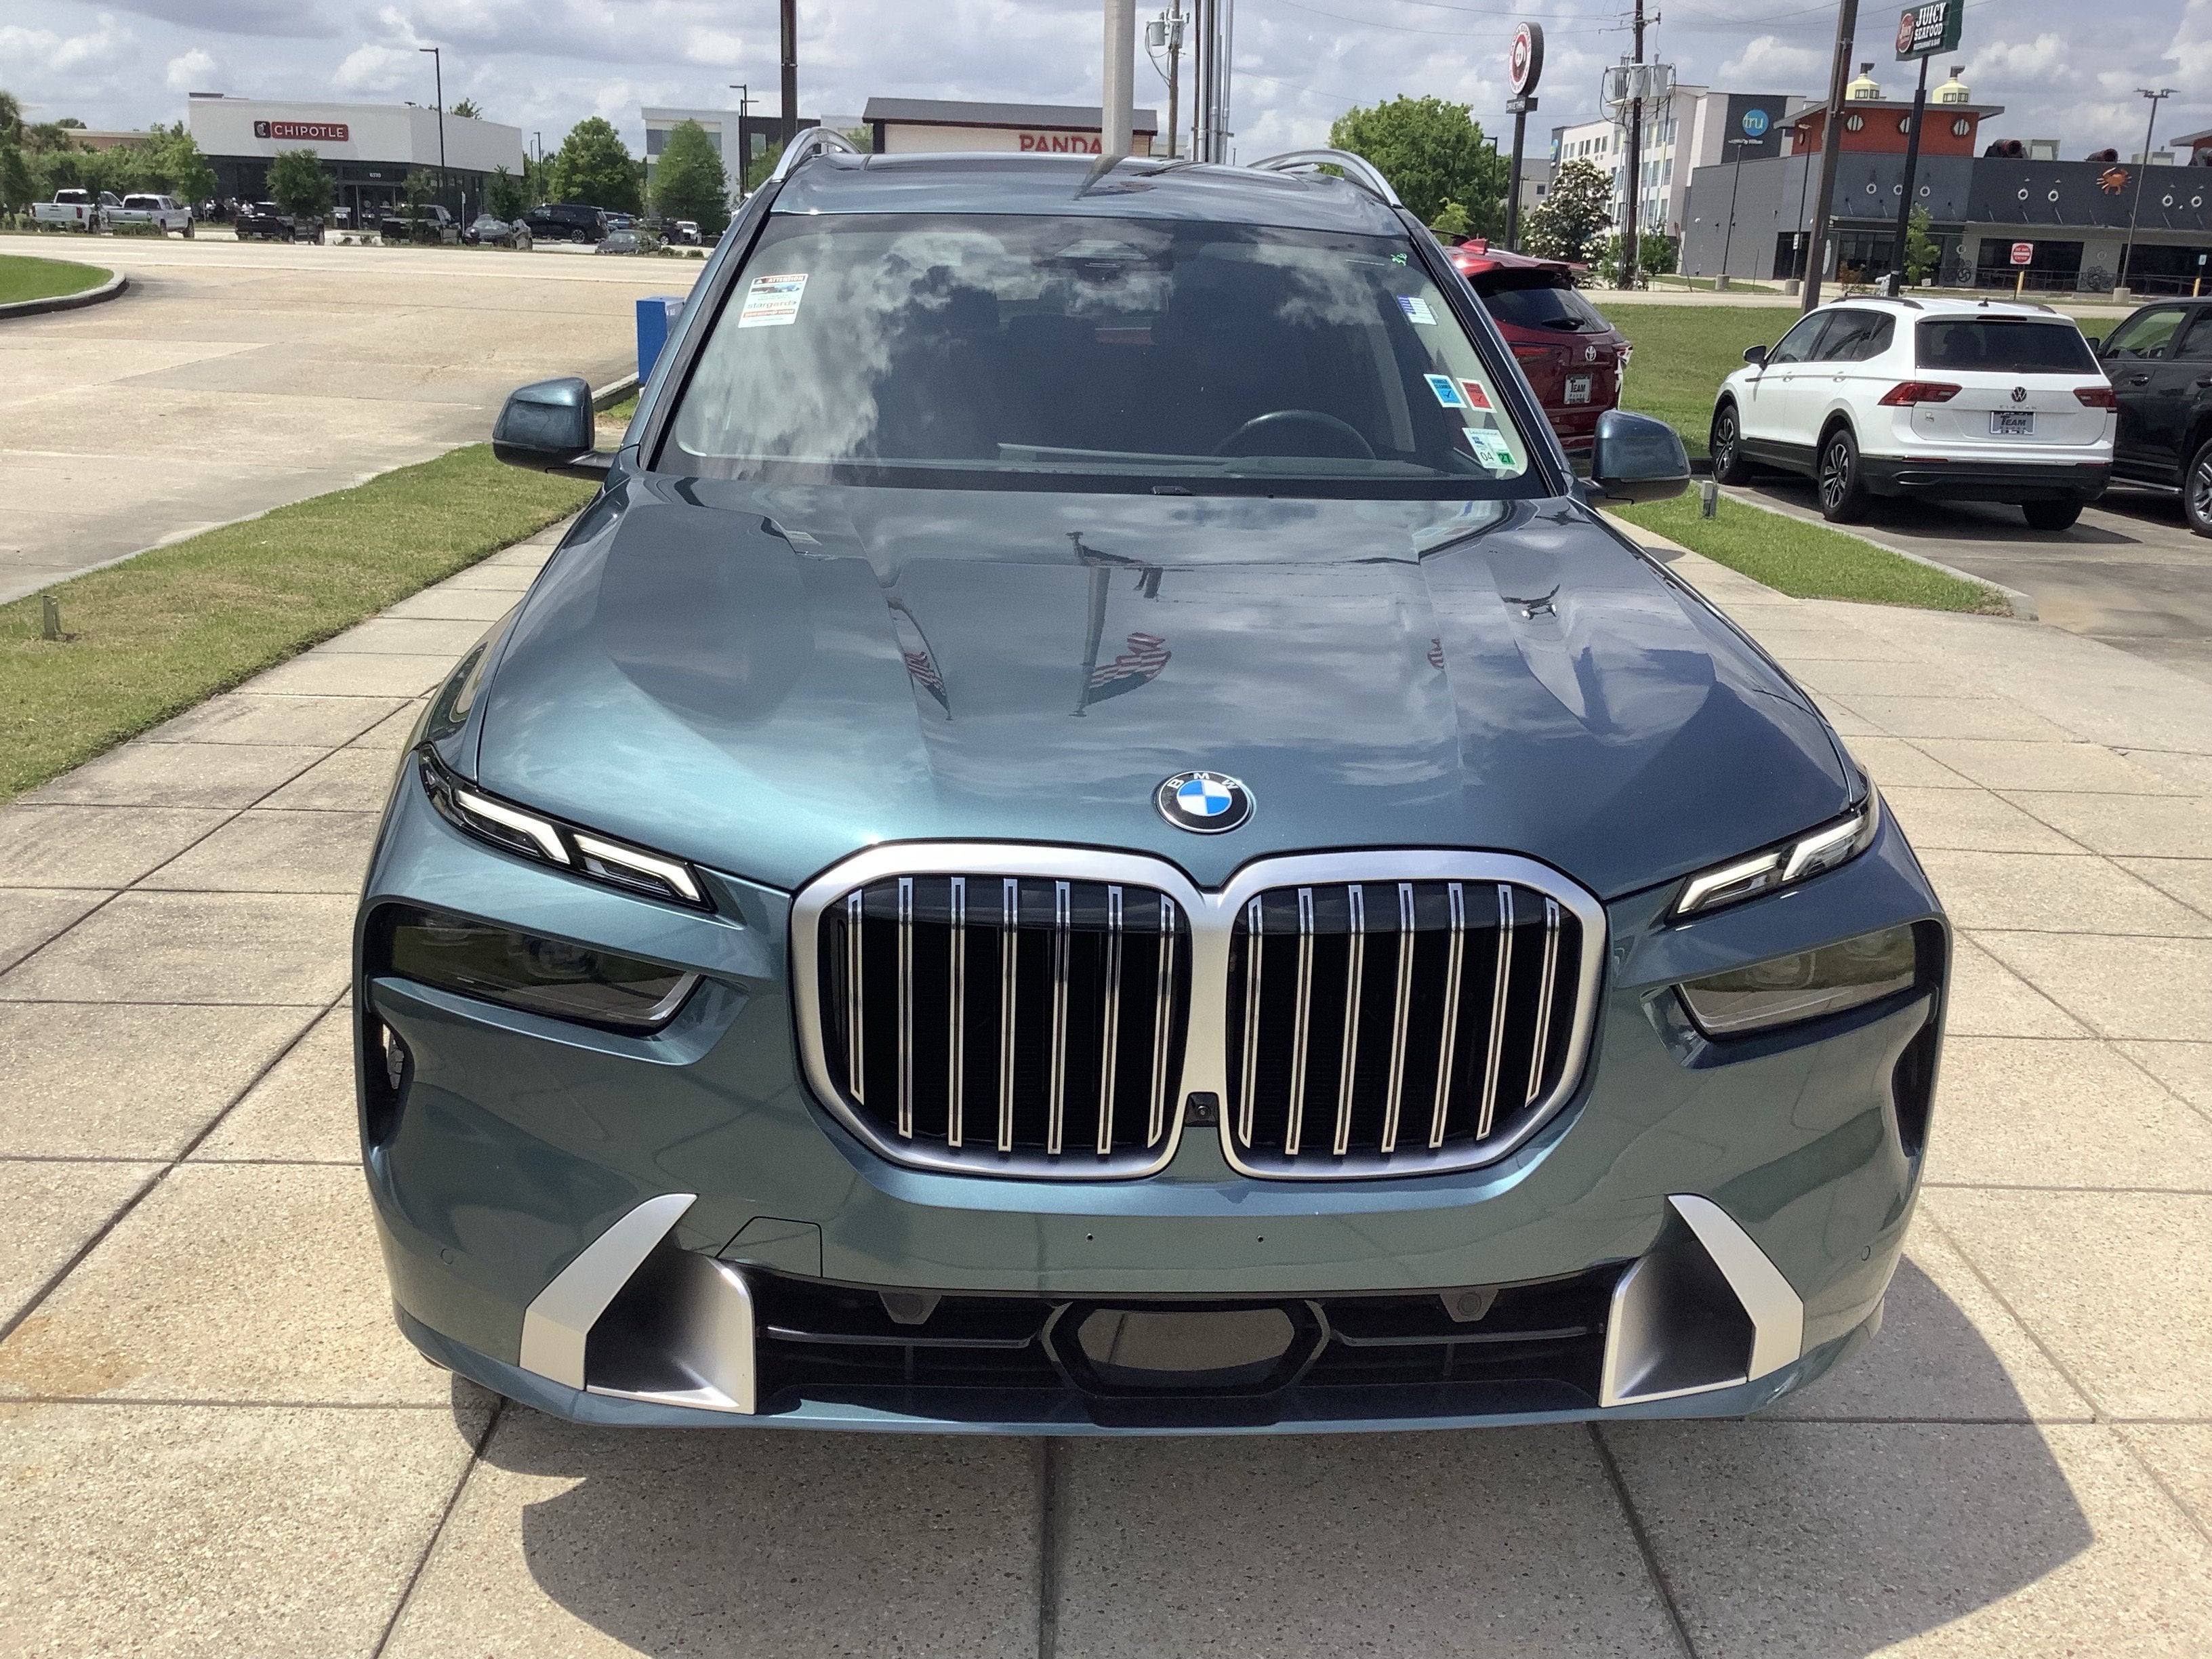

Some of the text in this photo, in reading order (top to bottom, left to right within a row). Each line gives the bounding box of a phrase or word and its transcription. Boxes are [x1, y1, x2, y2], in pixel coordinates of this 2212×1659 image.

[1916, 2, 1946, 27] JUICY
[1914, 23, 1943, 41] SEAFOOD
[1744, 115, 1764, 129] tru
[274, 125, 344, 138] CHIPOTLE
[1019, 134, 1102, 154] PANDA
[1570, 380, 1586, 392] TEAM
[2001, 415, 2026, 426] TEAM
[1480, 451, 1511, 463] 04 27
[1167, 772, 1240, 790] BMW
